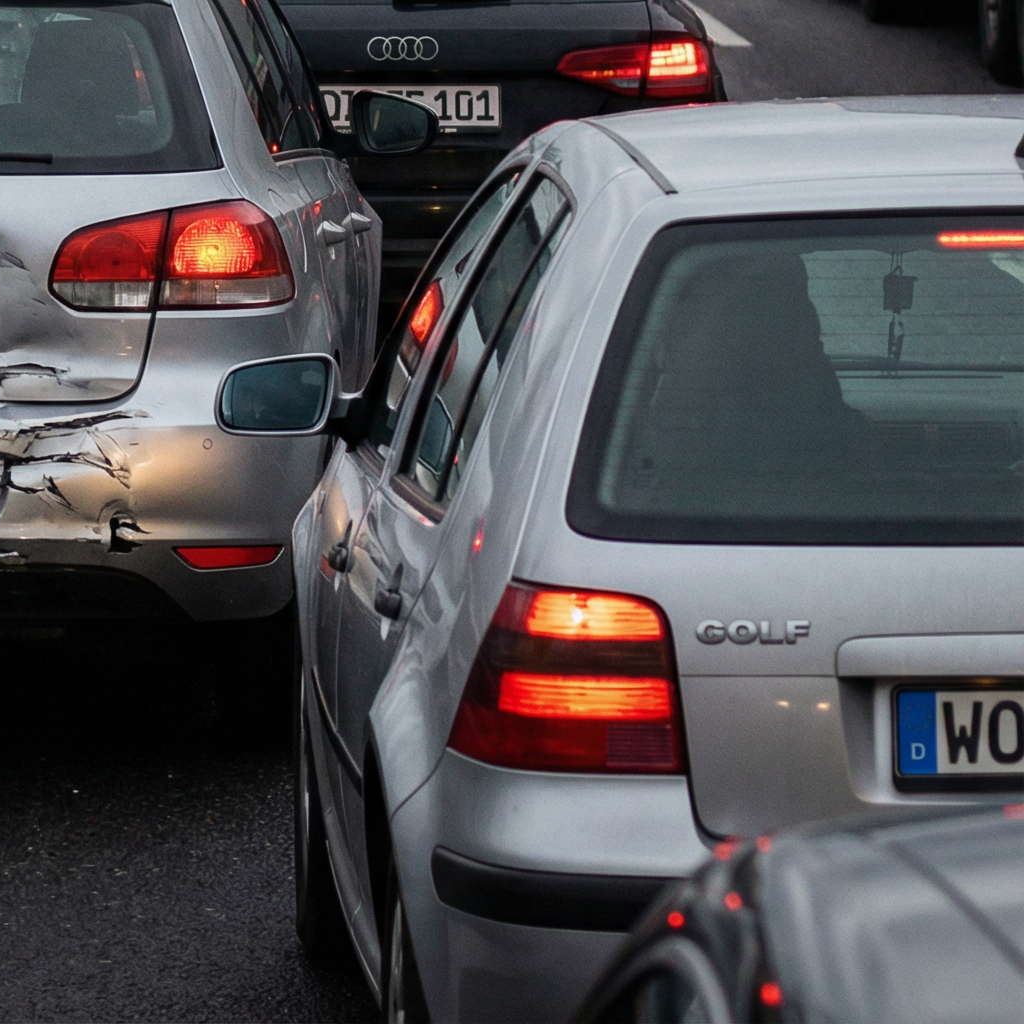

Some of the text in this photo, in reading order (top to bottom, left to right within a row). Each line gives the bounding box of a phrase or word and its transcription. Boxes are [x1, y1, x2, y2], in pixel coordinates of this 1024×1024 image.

[434, 90, 494, 121] 101
[695, 619, 811, 645] GOLF
[942, 699, 1024, 765] WO
[911, 743, 926, 760] D
